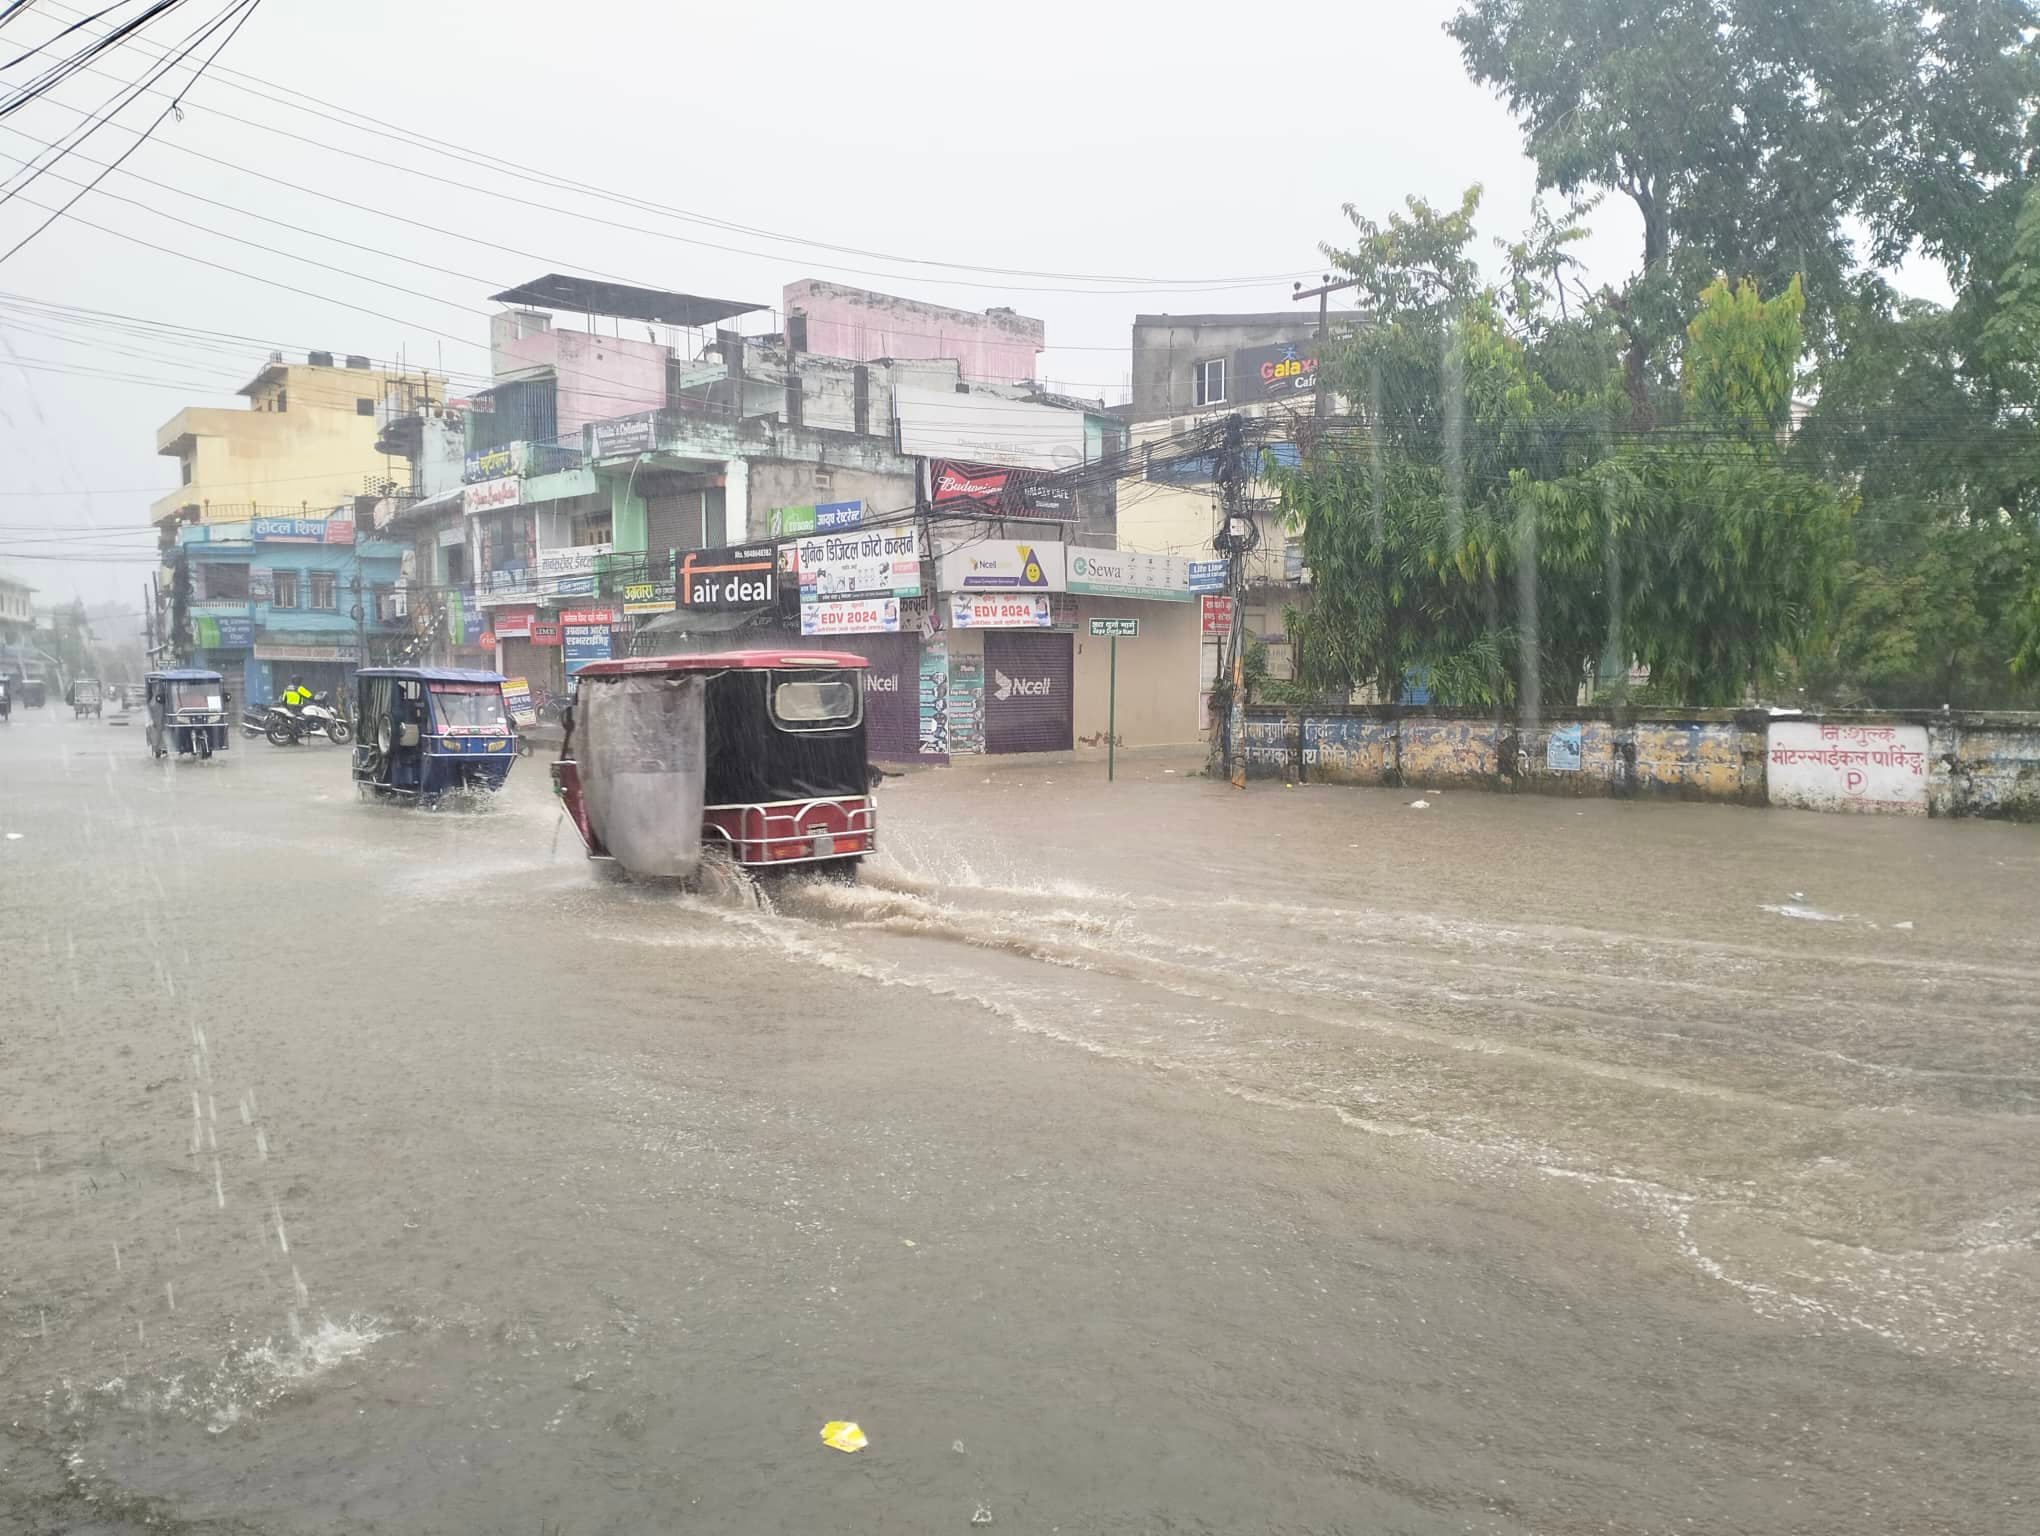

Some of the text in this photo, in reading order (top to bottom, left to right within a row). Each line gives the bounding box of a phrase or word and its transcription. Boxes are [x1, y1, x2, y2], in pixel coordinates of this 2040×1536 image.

[937, 476, 1003, 494] Budweiser
[256, 519, 290, 534] होटल
[826, 538, 858, 560] डिजिटल
[861, 533, 881, 557] फोटो
[979, 560, 996, 569] Ncell
[680, 553, 719, 604] fair
[725, 574, 771, 602] deal
[821, 611, 877, 624] EDV 2024
[974, 605, 1030, 617] EDV 2024
[867, 675, 898, 692] Ncell
[1012, 678, 1050, 695] Ncell
